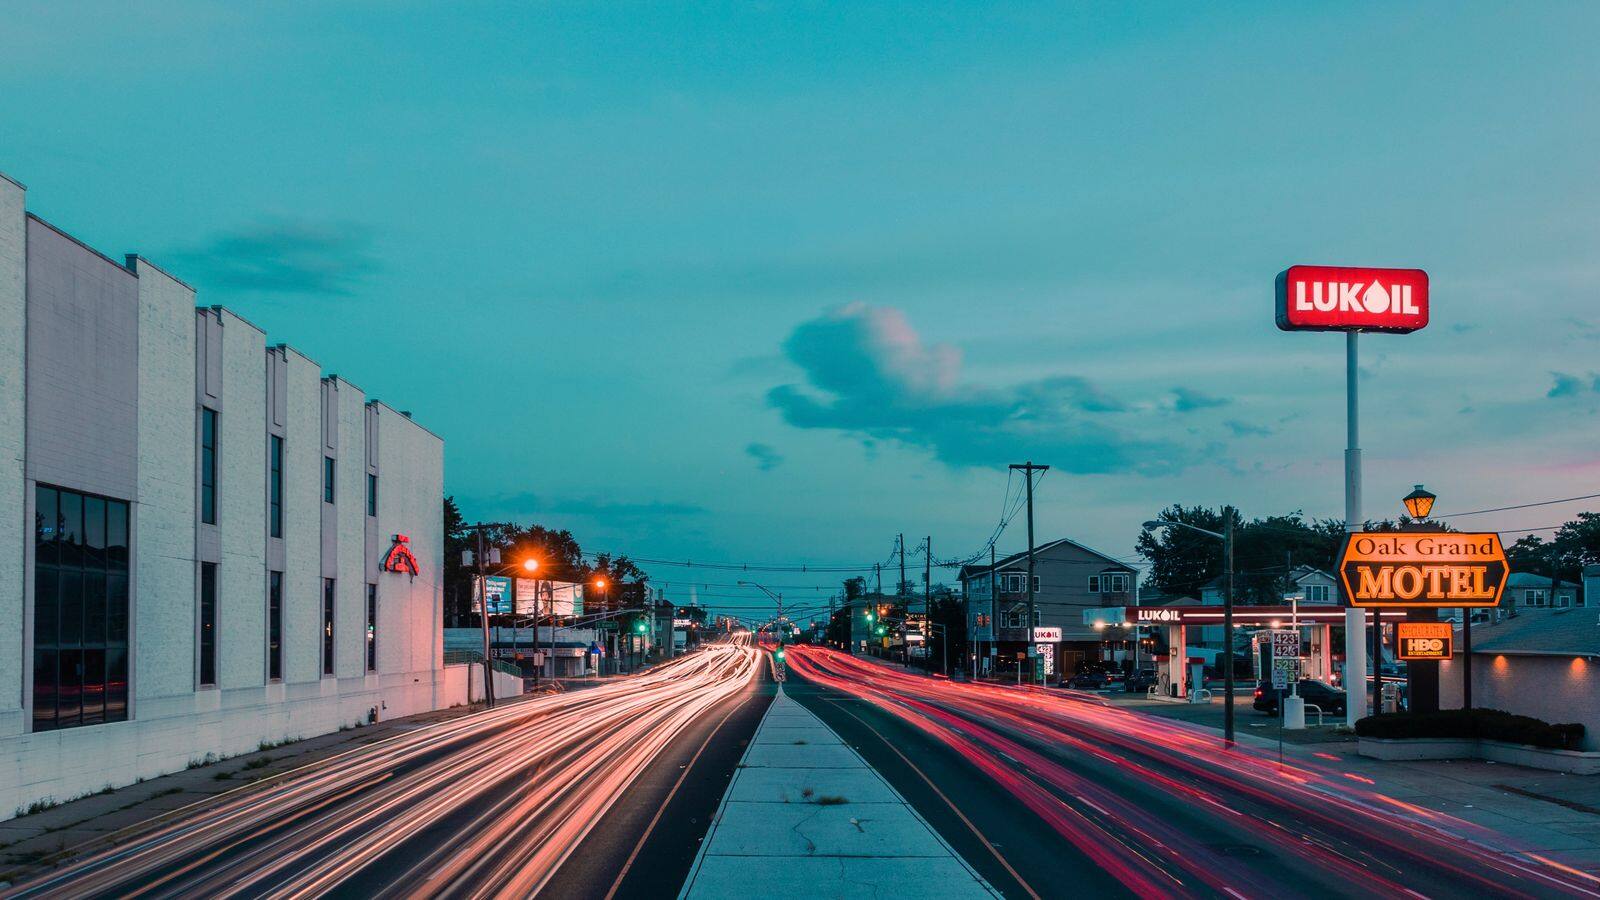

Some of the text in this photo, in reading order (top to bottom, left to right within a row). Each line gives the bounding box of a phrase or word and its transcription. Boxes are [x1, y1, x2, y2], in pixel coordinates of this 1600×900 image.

[1296, 280, 1419, 314] LUKOIL
[1355, 538, 1495, 555] Oak Grand
[1356, 565, 1496, 599] MOTEL
[1138, 609, 1181, 621] LUKOIL
[1034, 631, 1059, 639] UKOIL
[1276, 634, 1295, 644] 423
[1408, 639, 1443, 651] HBO
